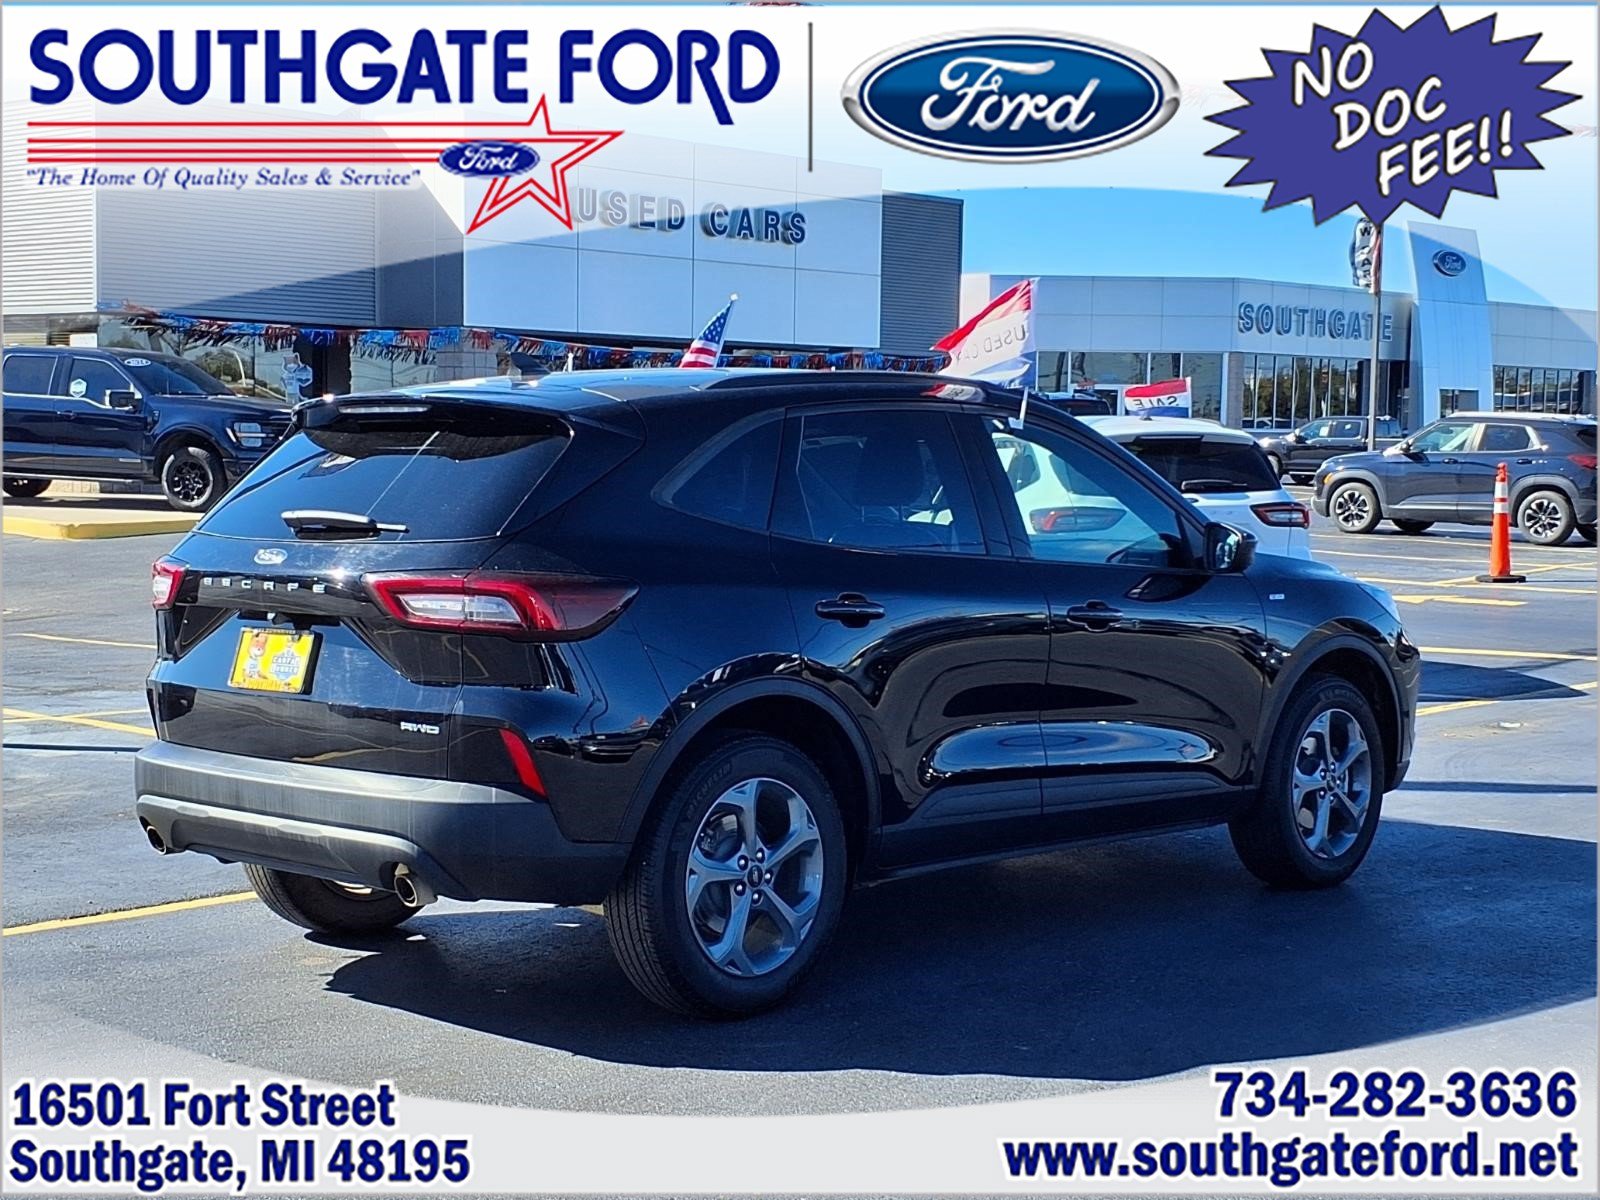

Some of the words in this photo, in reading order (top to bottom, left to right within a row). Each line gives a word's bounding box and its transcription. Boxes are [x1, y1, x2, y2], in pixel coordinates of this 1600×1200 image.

[575, 187, 686, 232] USED
[700, 200, 807, 244] CARS
[1238, 302, 1393, 342] SOUTHGATE
[203, 577, 326, 594] ESCAPE
